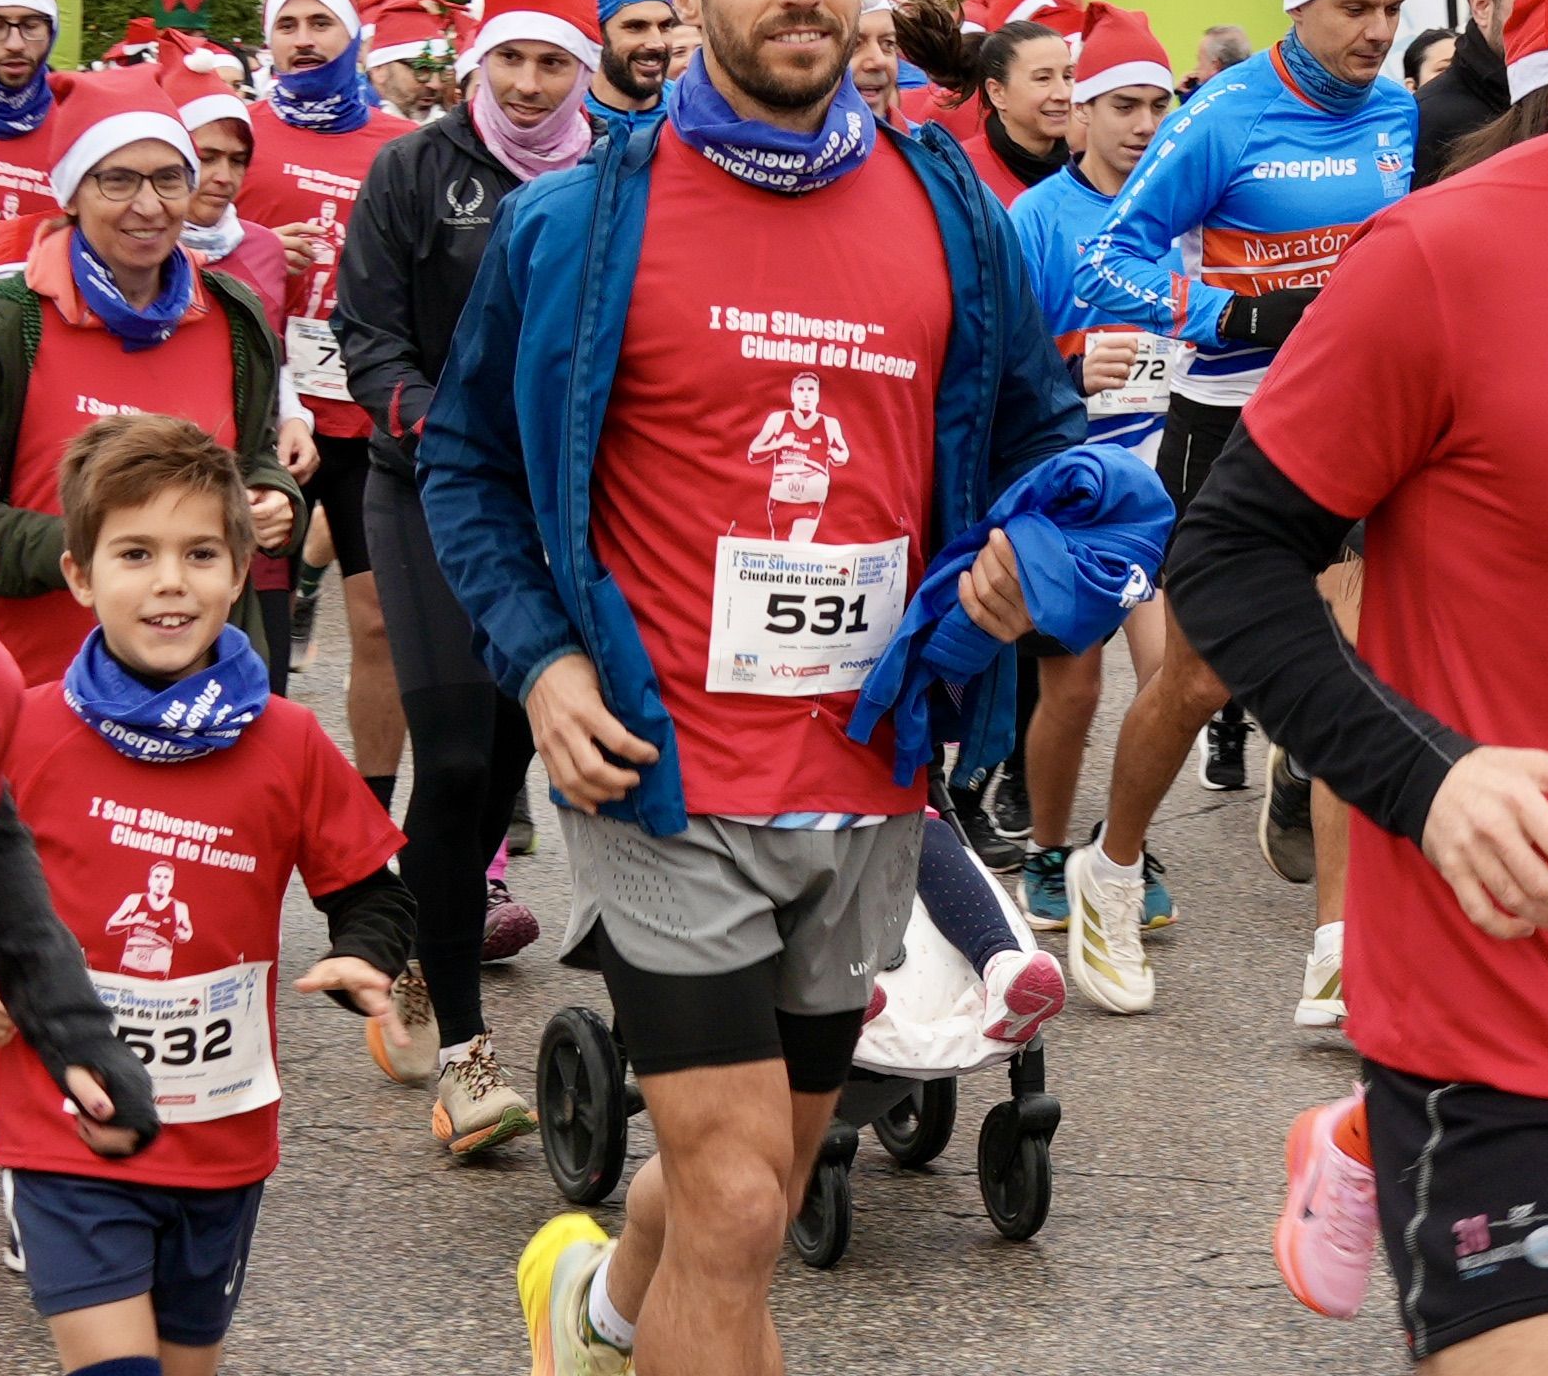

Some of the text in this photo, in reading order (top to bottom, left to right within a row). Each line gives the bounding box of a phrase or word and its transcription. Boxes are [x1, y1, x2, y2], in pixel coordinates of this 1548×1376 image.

[1252, 156, 1357, 182] enerplus
[1244, 228, 1350, 263] Maratón
[1251, 270, 1332, 298] Lucen
[709, 306, 721, 330] I
[726, 307, 767, 333] San
[771, 311, 866, 344] Silvestre
[741, 335, 916, 380] Ciudad de Lucena
[1133, 359, 1166, 381] 72
[740, 569, 783, 584] Ciudad
[787, 573, 802, 585] de
[805, 574, 847, 586] Lucena
[742, 556, 764, 570] San
[768, 558, 823, 573] Silvestre
[764, 593, 870, 637] 531
[89, 796, 102, 817] I
[102, 800, 138, 826] San
[139, 808, 219, 844] Silvestre
[111, 824, 257, 873] Ciudad de Lucena
[117, 1018, 233, 1066] 532
